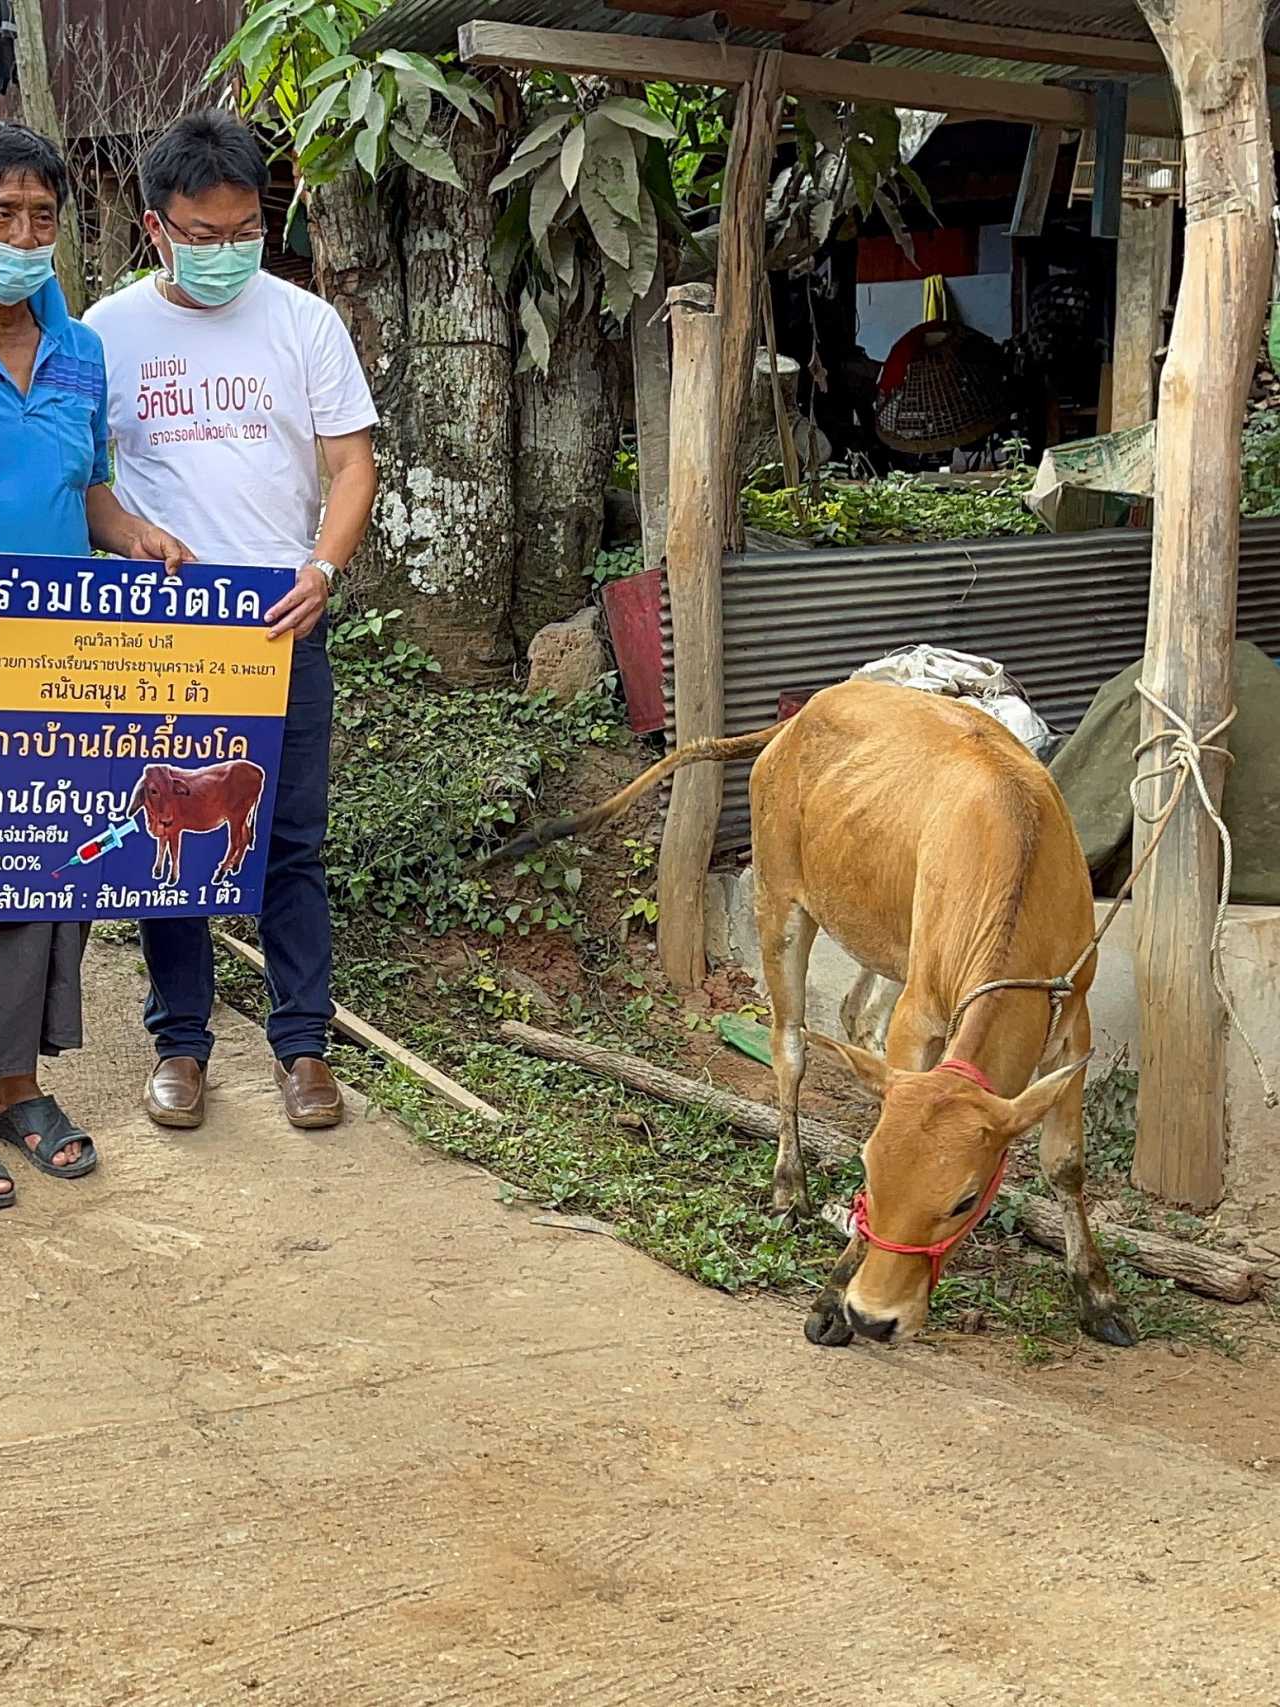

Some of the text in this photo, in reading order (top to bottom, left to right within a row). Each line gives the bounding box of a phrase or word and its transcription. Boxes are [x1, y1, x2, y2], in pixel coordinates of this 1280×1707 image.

[141, 354, 187, 380] แม่แจ่ม
[136, 376, 273, 421] วัคซีน 100%
[242, 424, 268, 440] 2021
[74, 632, 174, 651] คุณวิลาวัลย์ ปาลี
[209, 661, 226, 675] 24
[231, 663, 276, 676] จ.พะเยา
[40, 676, 209, 708] สนับสนุน วัว 1 ตัว
[95, 882, 190, 908] สัปดาห์ละ
[197, 885, 207, 905] 1
[215, 881, 241, 904] ตัว
